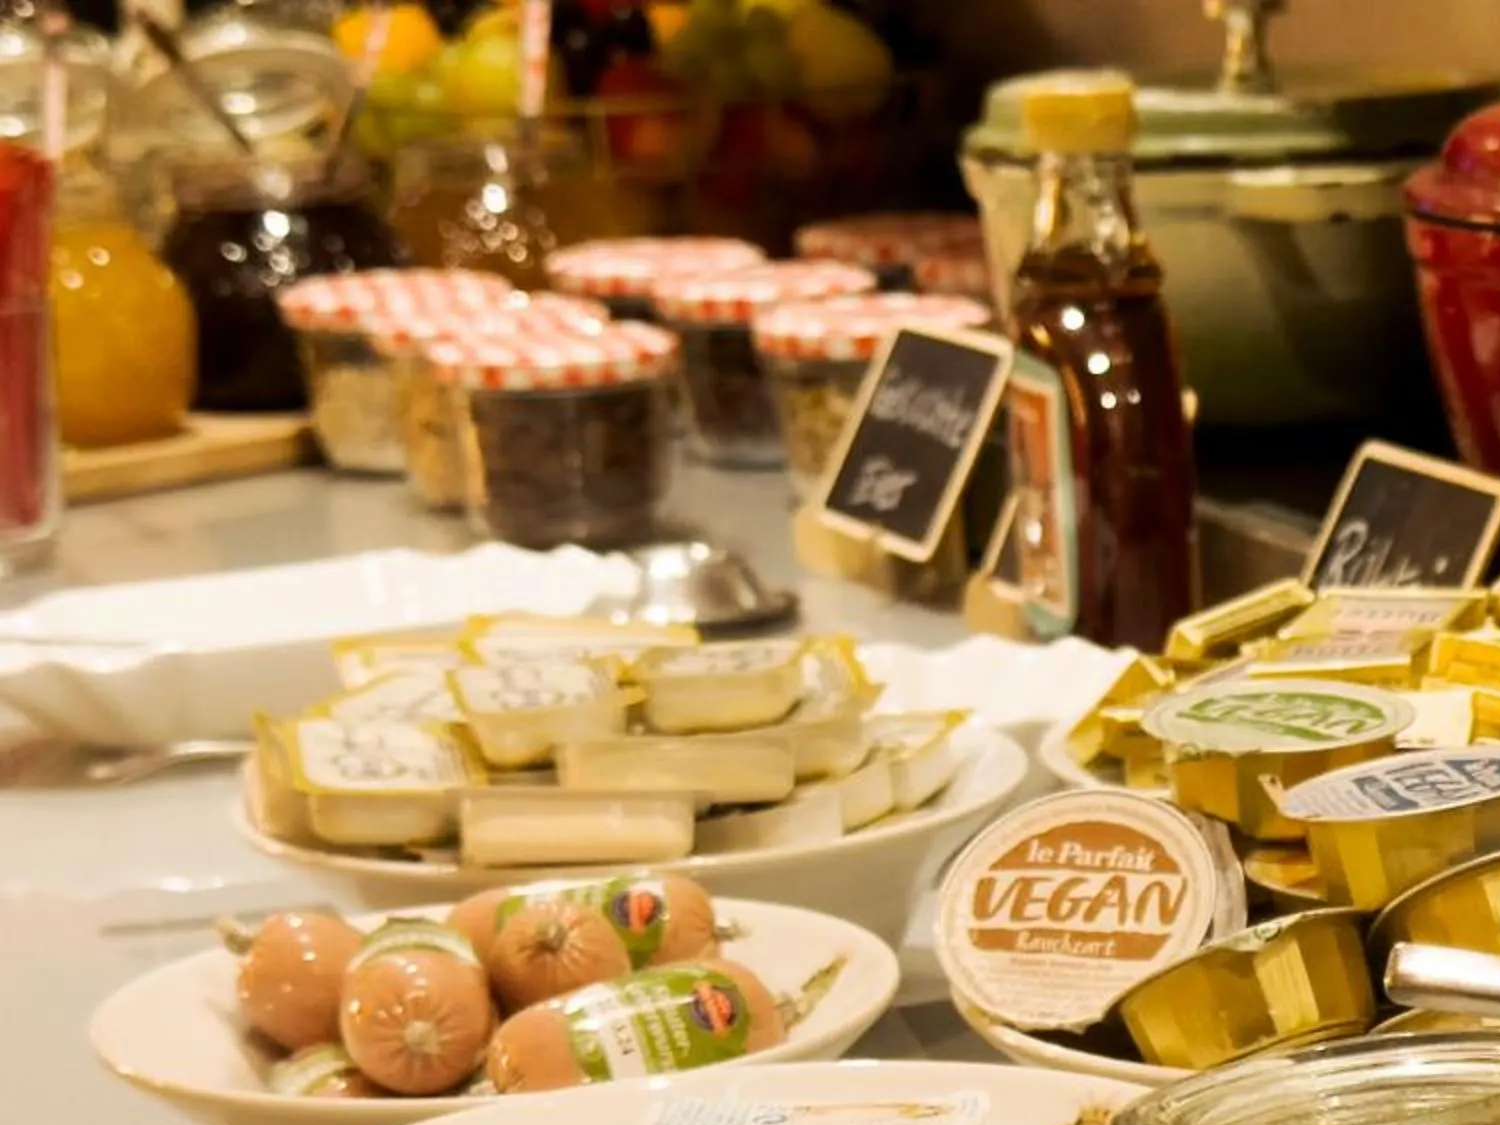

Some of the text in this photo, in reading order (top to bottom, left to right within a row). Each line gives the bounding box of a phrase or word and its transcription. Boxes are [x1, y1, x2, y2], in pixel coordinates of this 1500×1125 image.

[1026, 839, 1157, 871] le Parfait
[971, 874, 1189, 927] VEGAN
